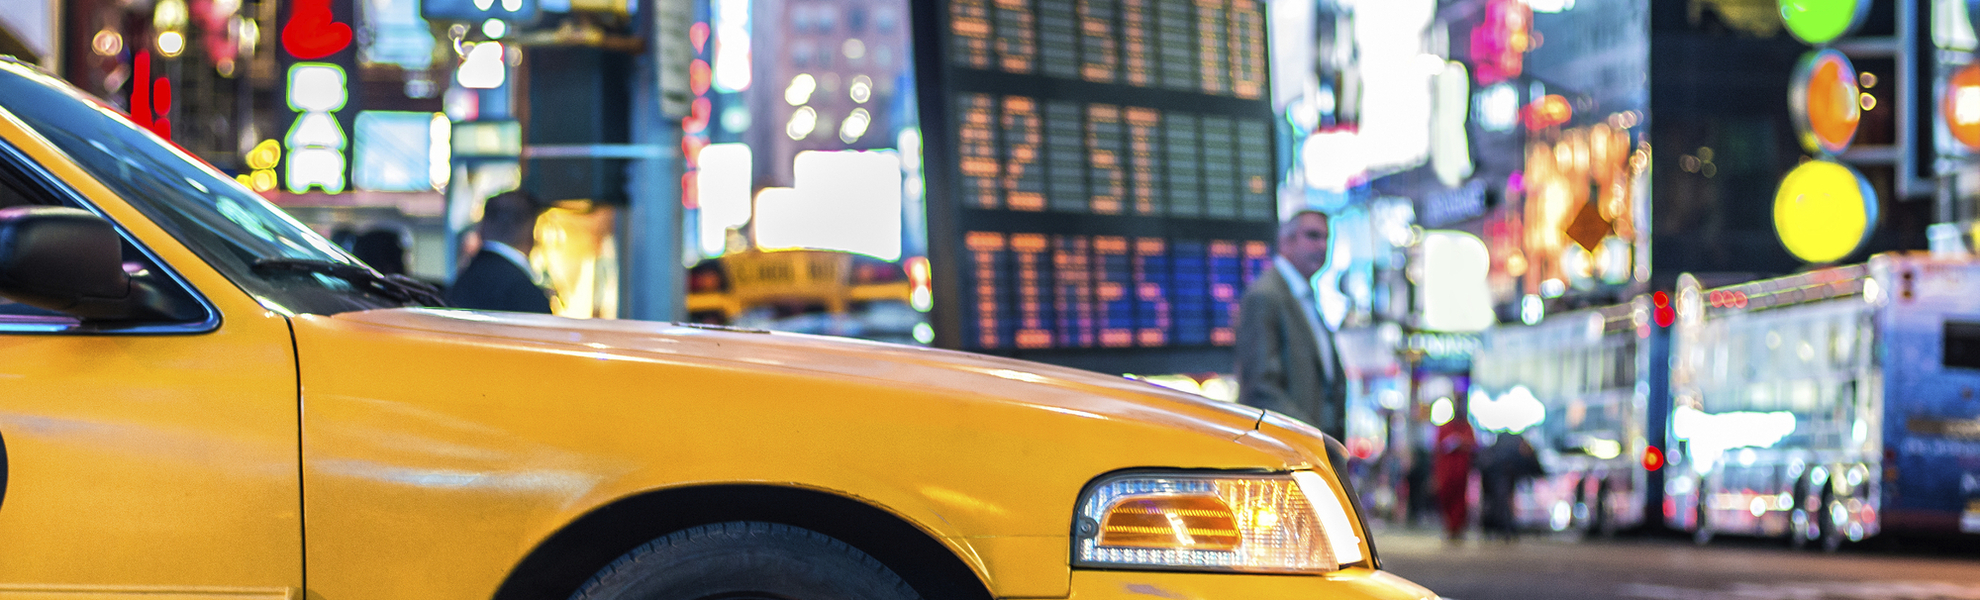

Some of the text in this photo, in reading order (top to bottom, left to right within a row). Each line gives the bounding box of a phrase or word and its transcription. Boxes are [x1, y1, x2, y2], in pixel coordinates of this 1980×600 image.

[959, 93, 1161, 215] 42 ST
[965, 231, 1170, 348] TIMES
